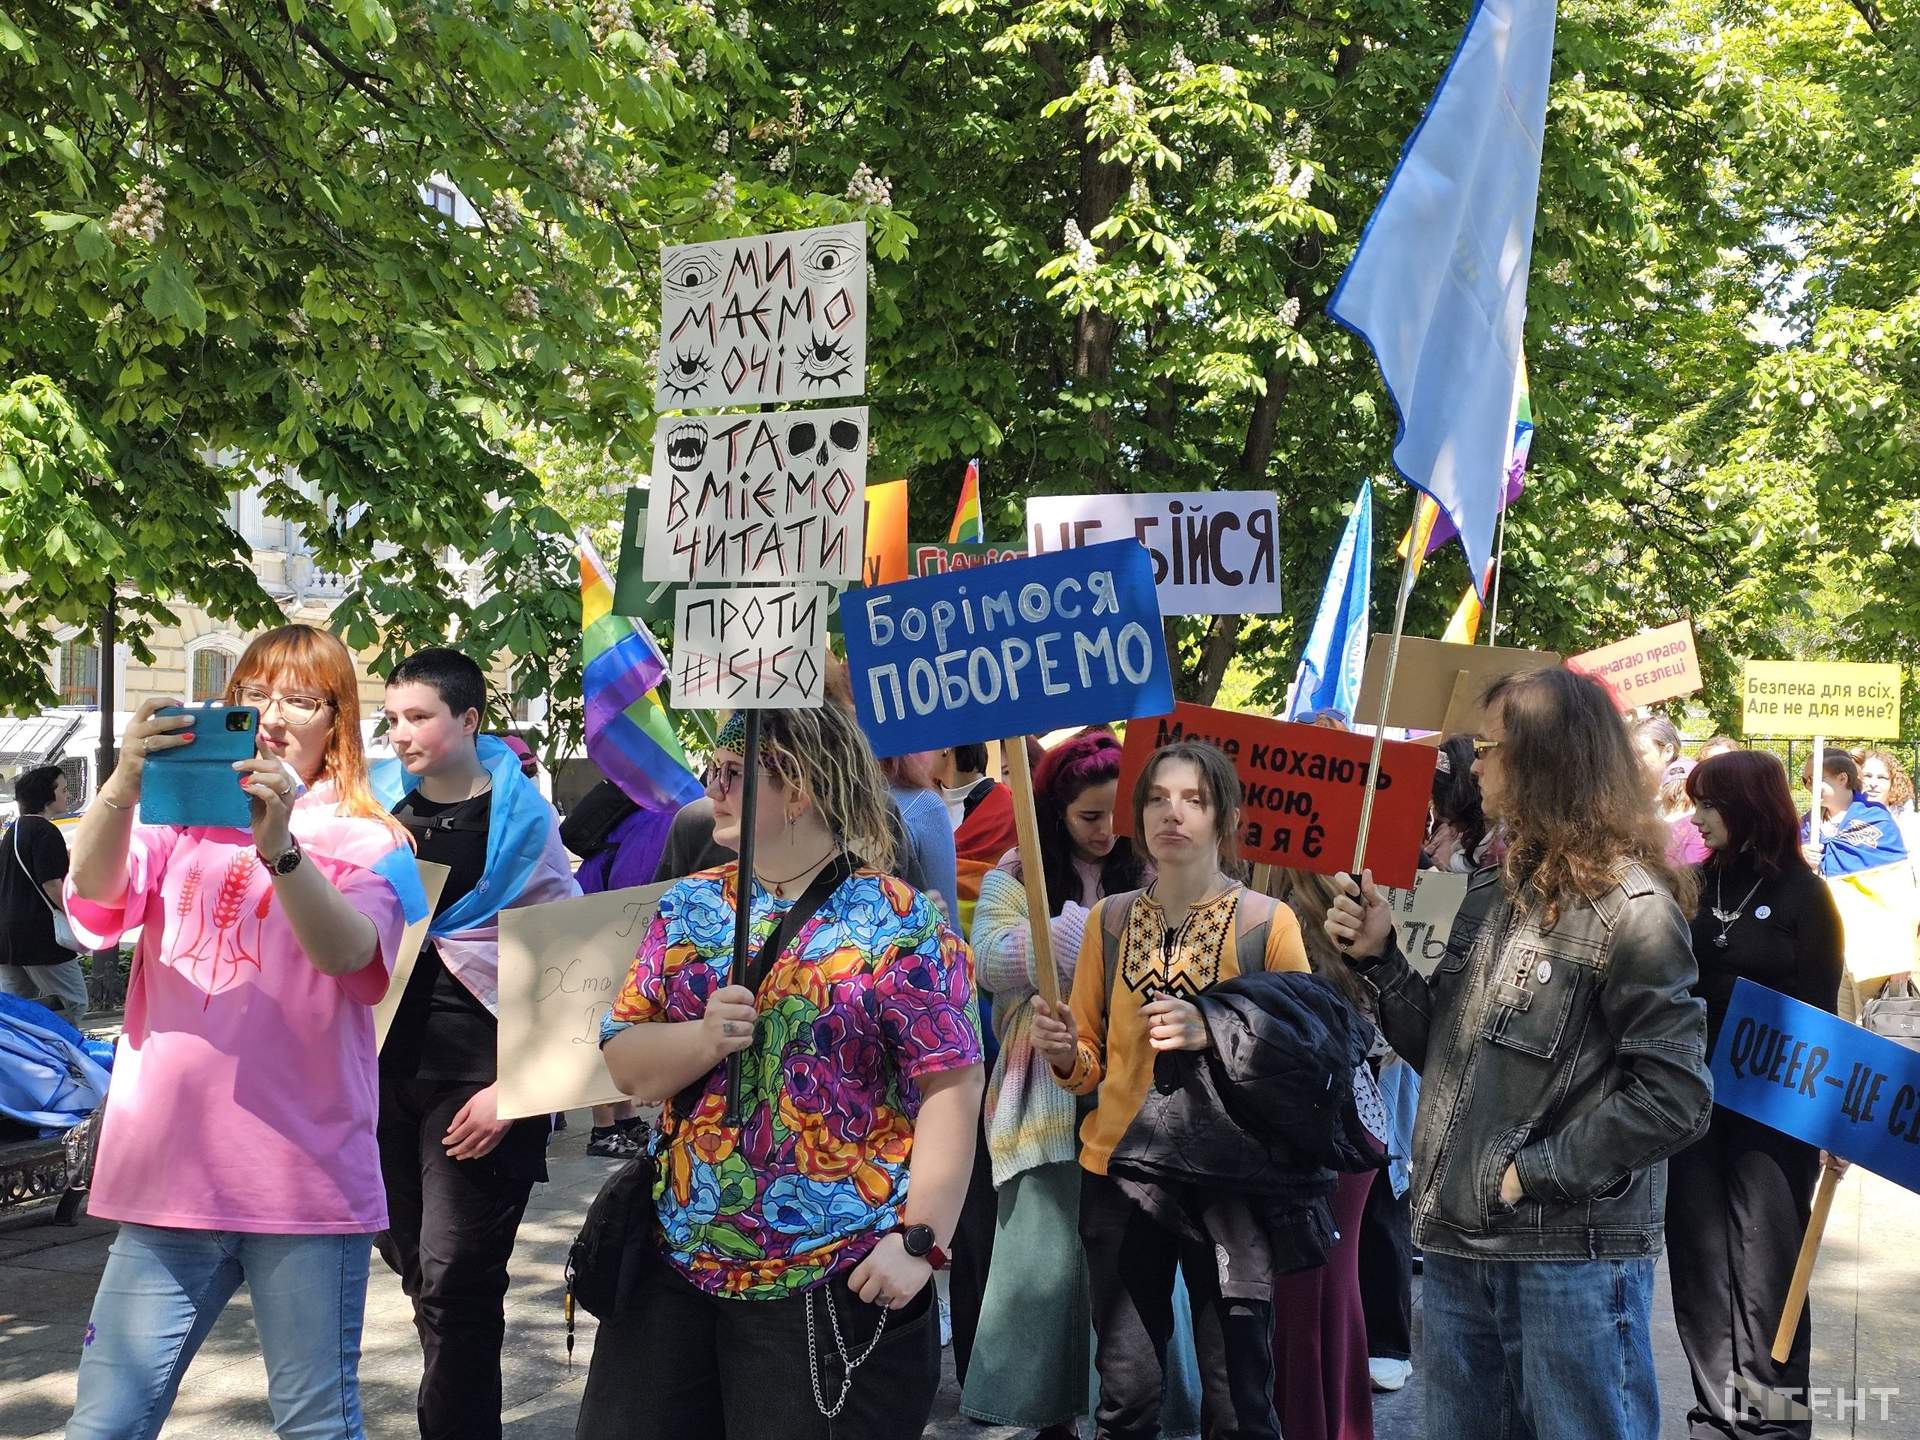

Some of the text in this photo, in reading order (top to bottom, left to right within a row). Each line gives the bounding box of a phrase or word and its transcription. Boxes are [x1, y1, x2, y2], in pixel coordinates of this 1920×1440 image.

[722, 241, 797, 297] МИ
[669, 286, 856, 348] МАЄМО
[712, 419, 786, 475] ТА
[672, 515, 849, 581] ЧИТАТИ
[685, 591, 818, 647] ПРОТИ
[867, 621, 1154, 724] ПОБОРЕМО
[1647, 639, 1687, 663] право
[1747, 697, 1895, 719] Але не для мене?
[1748, 677, 1895, 700] Безпека для всіх.
[1249, 743, 1393, 791] кохають
